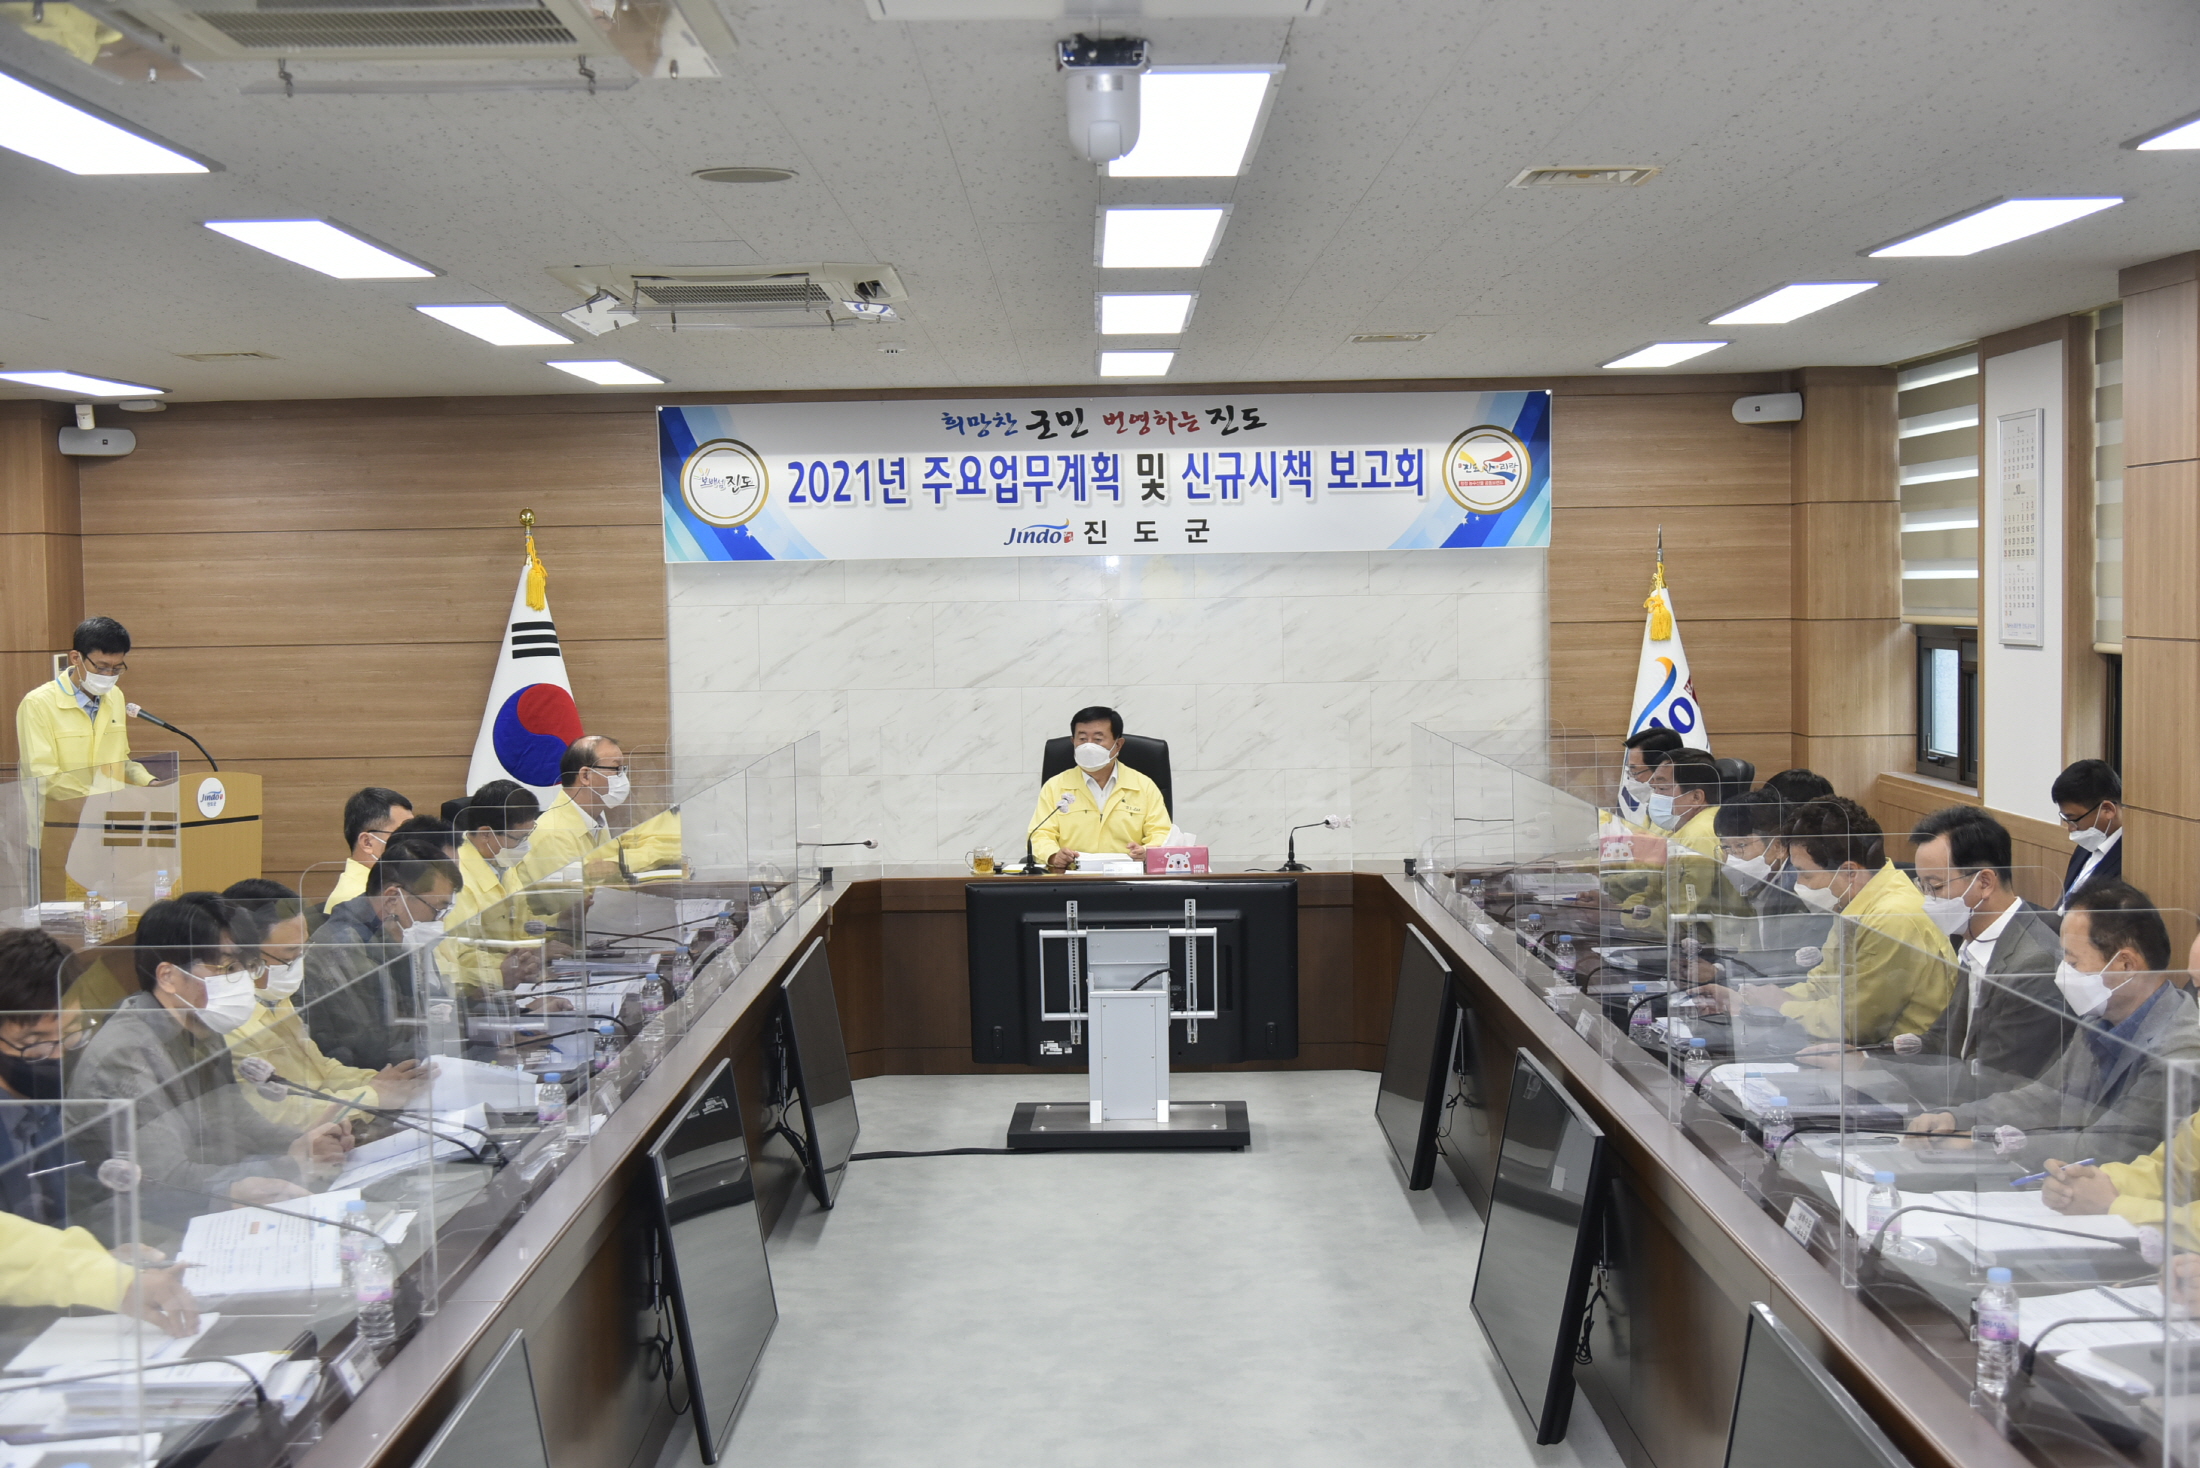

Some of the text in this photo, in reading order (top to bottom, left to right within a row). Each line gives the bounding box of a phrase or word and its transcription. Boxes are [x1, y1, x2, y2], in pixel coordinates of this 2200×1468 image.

[941, 404, 1268, 440] 희망찬 군민 번영하는 진도
[725, 474, 755, 493] 진도
[787, 447, 1424, 504] 2021년 주요업무계획 및 신규시책 보고회
[1003, 528, 1062, 546] Jindo
[200, 793, 220, 803] Jindo
